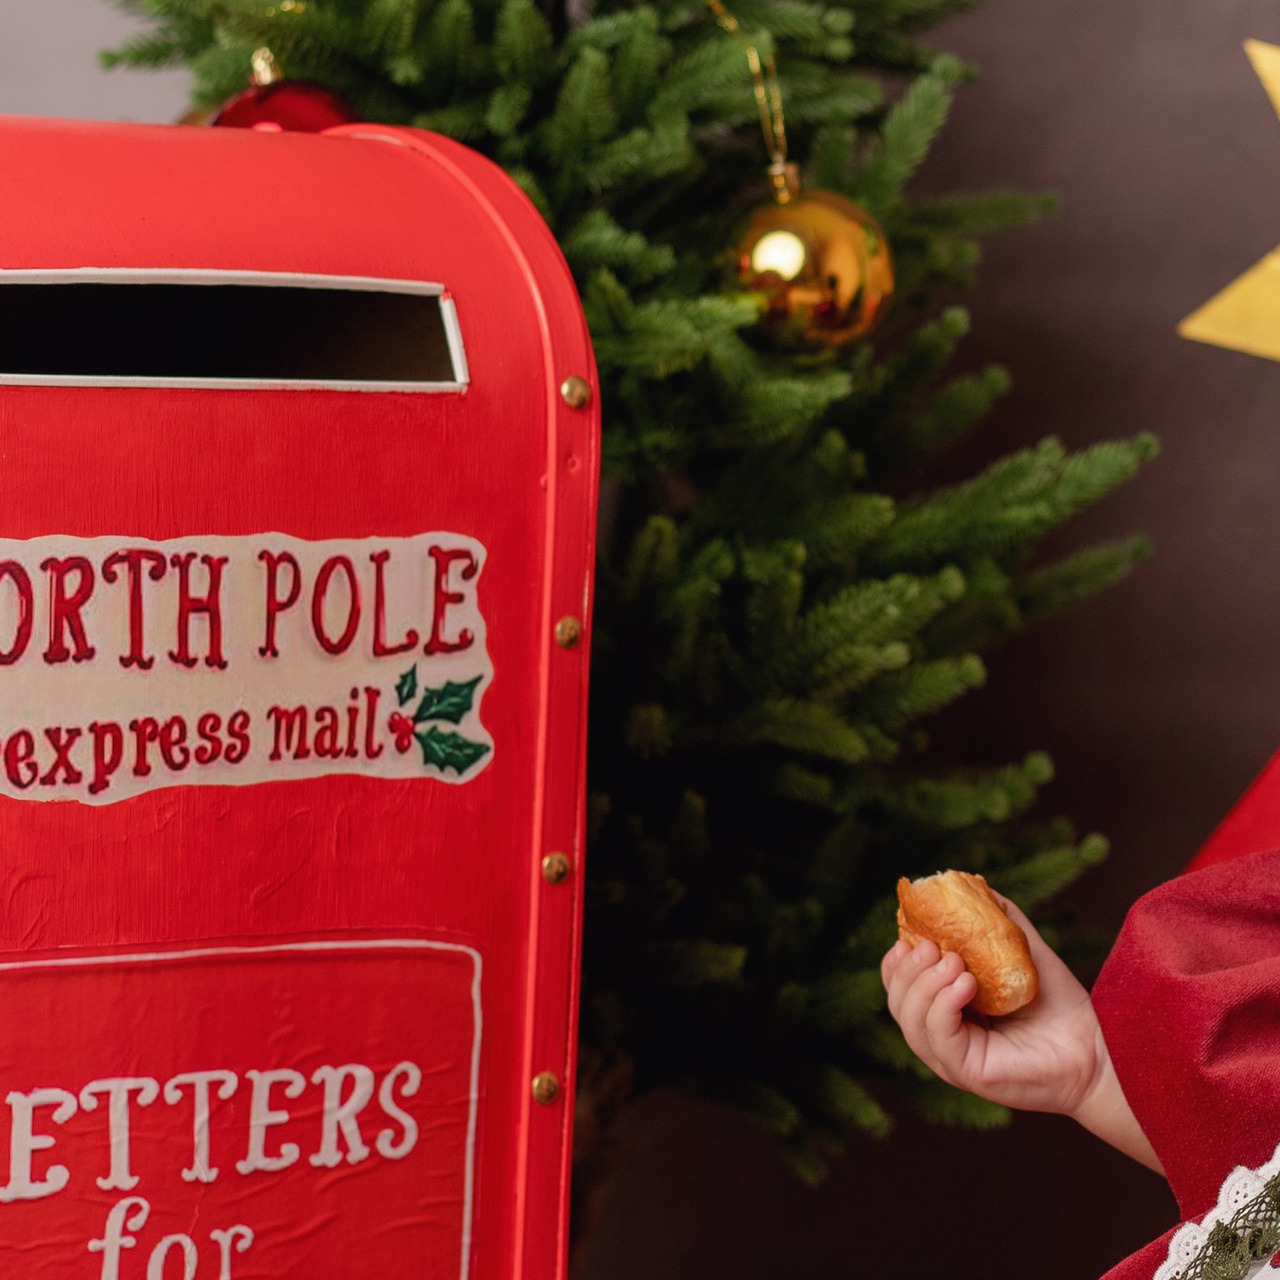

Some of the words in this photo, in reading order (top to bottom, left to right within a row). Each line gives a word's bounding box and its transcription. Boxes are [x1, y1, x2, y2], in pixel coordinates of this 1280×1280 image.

[257, 544, 479, 658] POLE
[3, 709, 251, 795] express
[266, 685, 385, 763] mail
[0, 1061, 422, 1202] ETTERS
